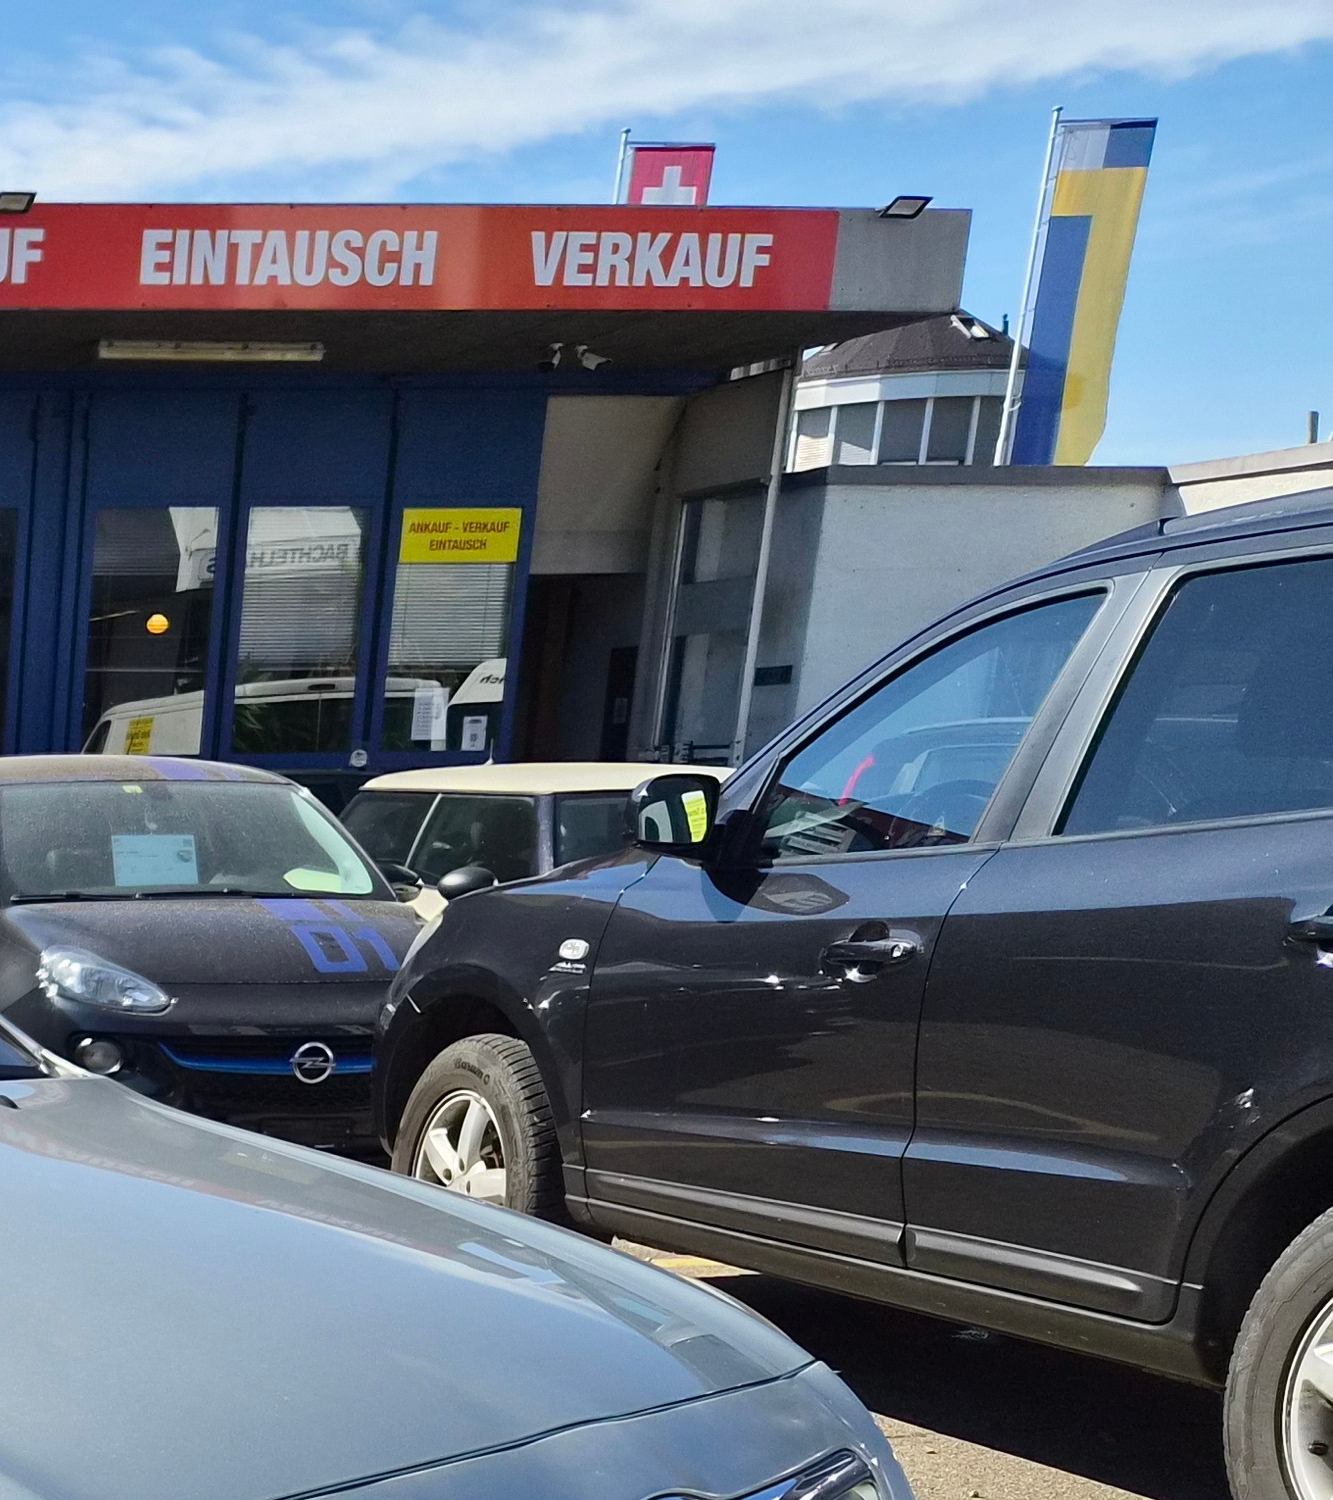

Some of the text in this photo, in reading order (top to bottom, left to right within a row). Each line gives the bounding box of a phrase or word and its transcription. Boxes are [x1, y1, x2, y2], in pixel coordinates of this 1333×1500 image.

[138, 229, 438, 288] EINTAUSCH
[531, 231, 773, 289] VERKAUF
[409, 521, 452, 534] ANKAUF
[462, 521, 510, 534] VERKAUF
[429, 538, 488, 552] EINTAUSCH
